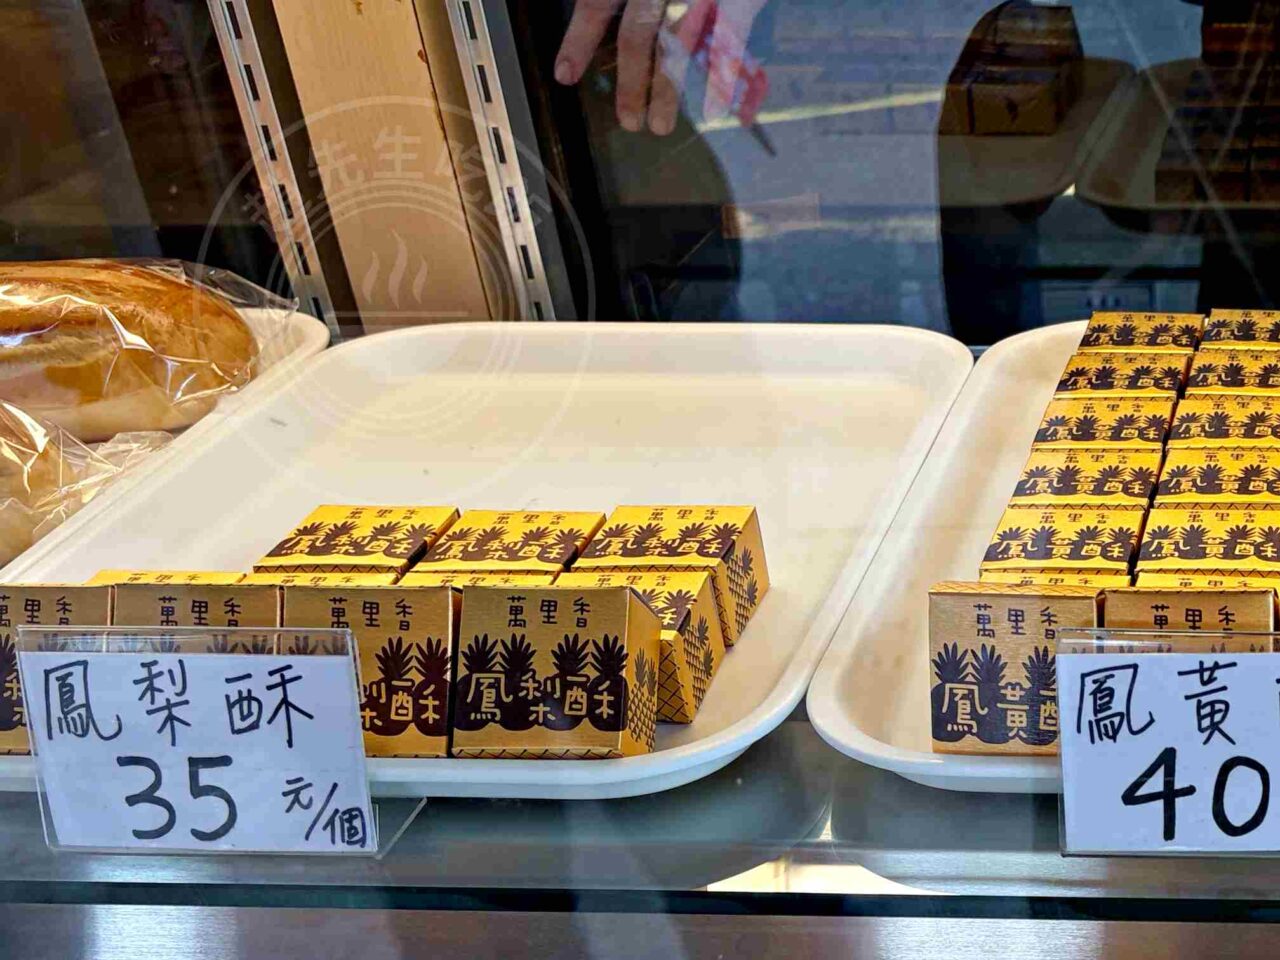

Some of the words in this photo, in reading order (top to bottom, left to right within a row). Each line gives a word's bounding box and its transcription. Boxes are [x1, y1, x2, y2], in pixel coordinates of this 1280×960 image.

[996, 537, 1130, 560] 鳳黃酥
[1149, 536, 1279, 560] 鳳黃酥
[328, 596, 414, 630] 萬里香
[508, 596, 592, 629] 萬里香
[973, 604, 1056, 639] 萬里香
[42, 658, 314, 749] 鳳梨酥
[361, 680, 440, 730] 梨酥
[466, 672, 616, 724] 鳳梨酥
[116, 754, 238, 842] 35
[281, 776, 367, 848] 元/個
[1121, 746, 1271, 842] 40
